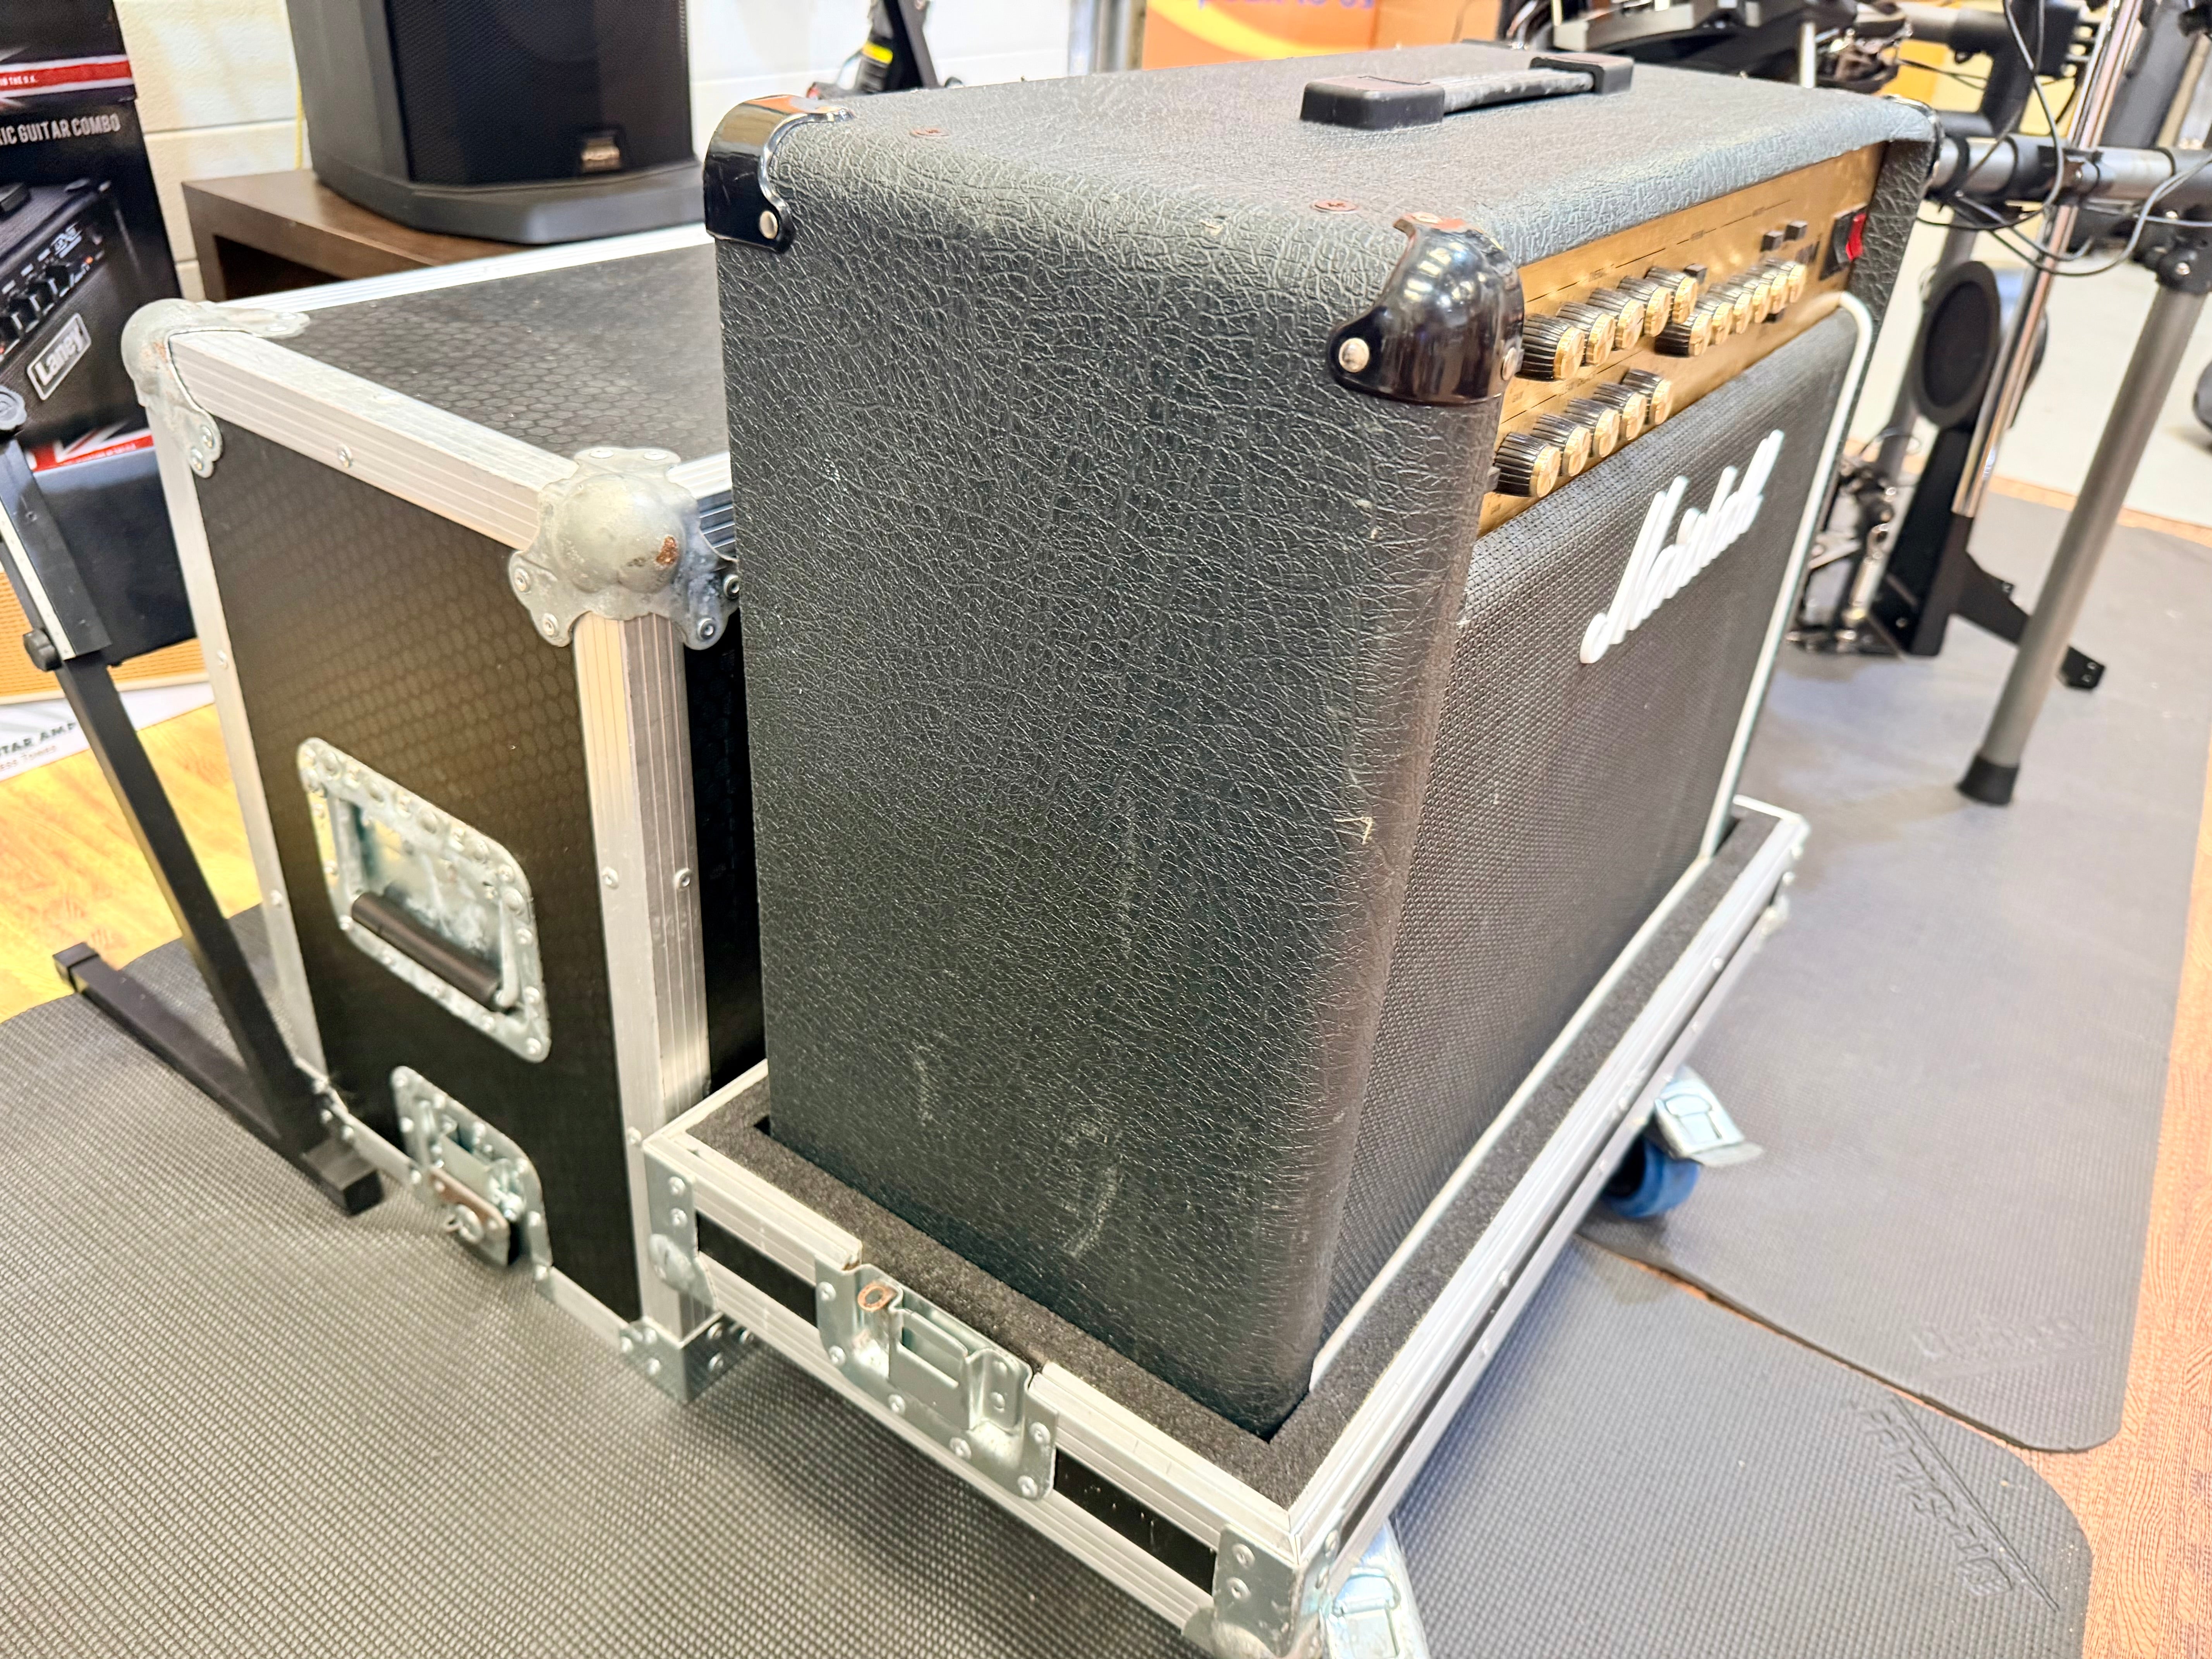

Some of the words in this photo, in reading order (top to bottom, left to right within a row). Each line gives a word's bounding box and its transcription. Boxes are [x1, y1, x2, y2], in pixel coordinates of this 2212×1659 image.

[17, 118, 71, 143] GUITAR
[71, 113, 121, 136] COMBO
[34, 322, 84, 386] Laney
[1580, 429, 1784, 664] Marshall
[0, 737, 33, 755] TAR
